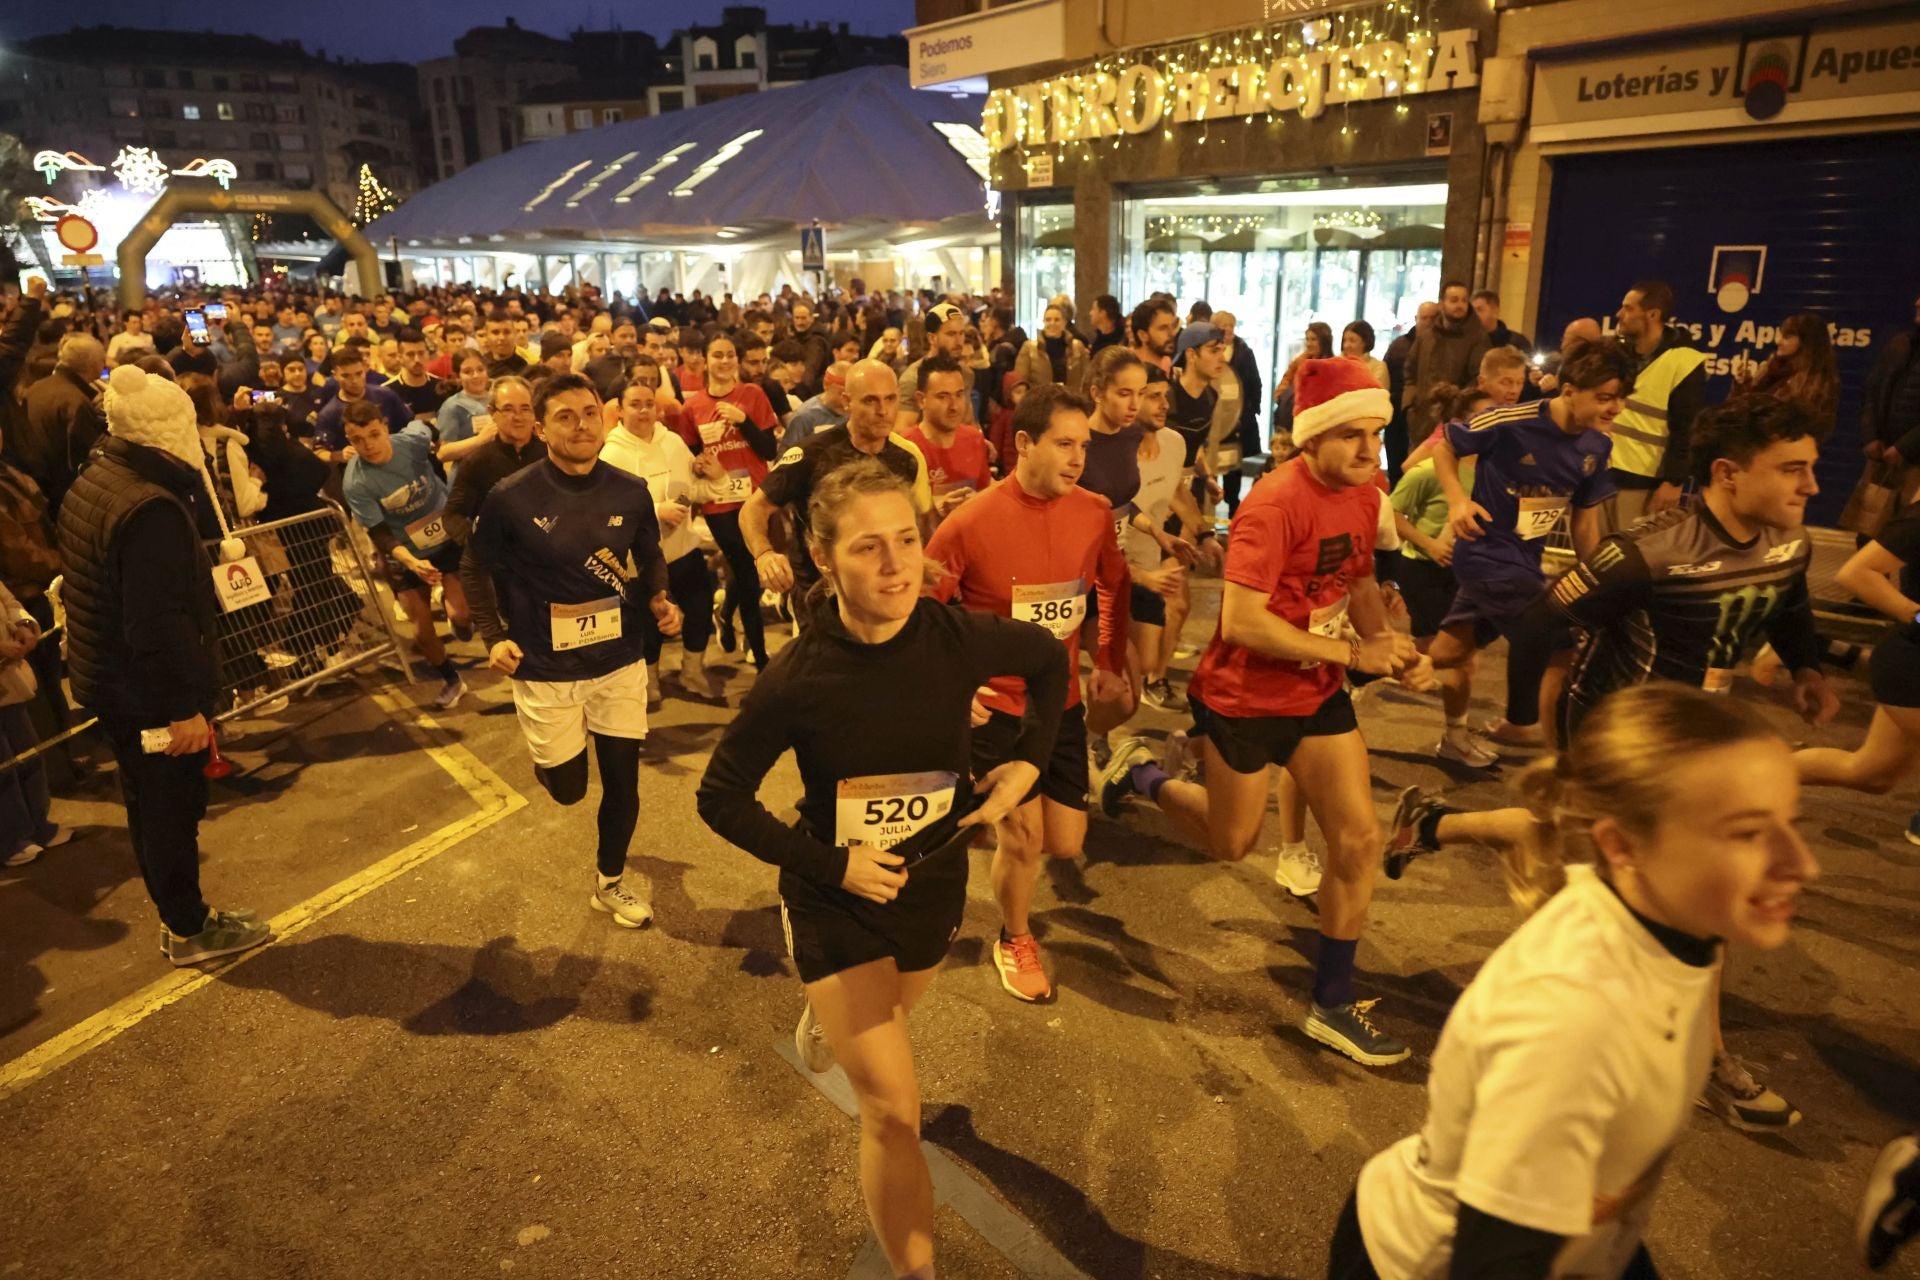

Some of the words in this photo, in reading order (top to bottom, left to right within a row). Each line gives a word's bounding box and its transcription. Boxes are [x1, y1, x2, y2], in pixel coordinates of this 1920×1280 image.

[919, 36, 973, 58] Podemos
[1578, 65, 1699, 102] Loterías
[1708, 66, 1730, 96] y
[983, 64, 1165, 150] OTERO
[1531, 510, 1560, 525] 729
[1030, 600, 1072, 622] 386
[576, 615, 597, 631] 71
[864, 796, 929, 825] 520
[879, 825, 912, 835] JULIA
